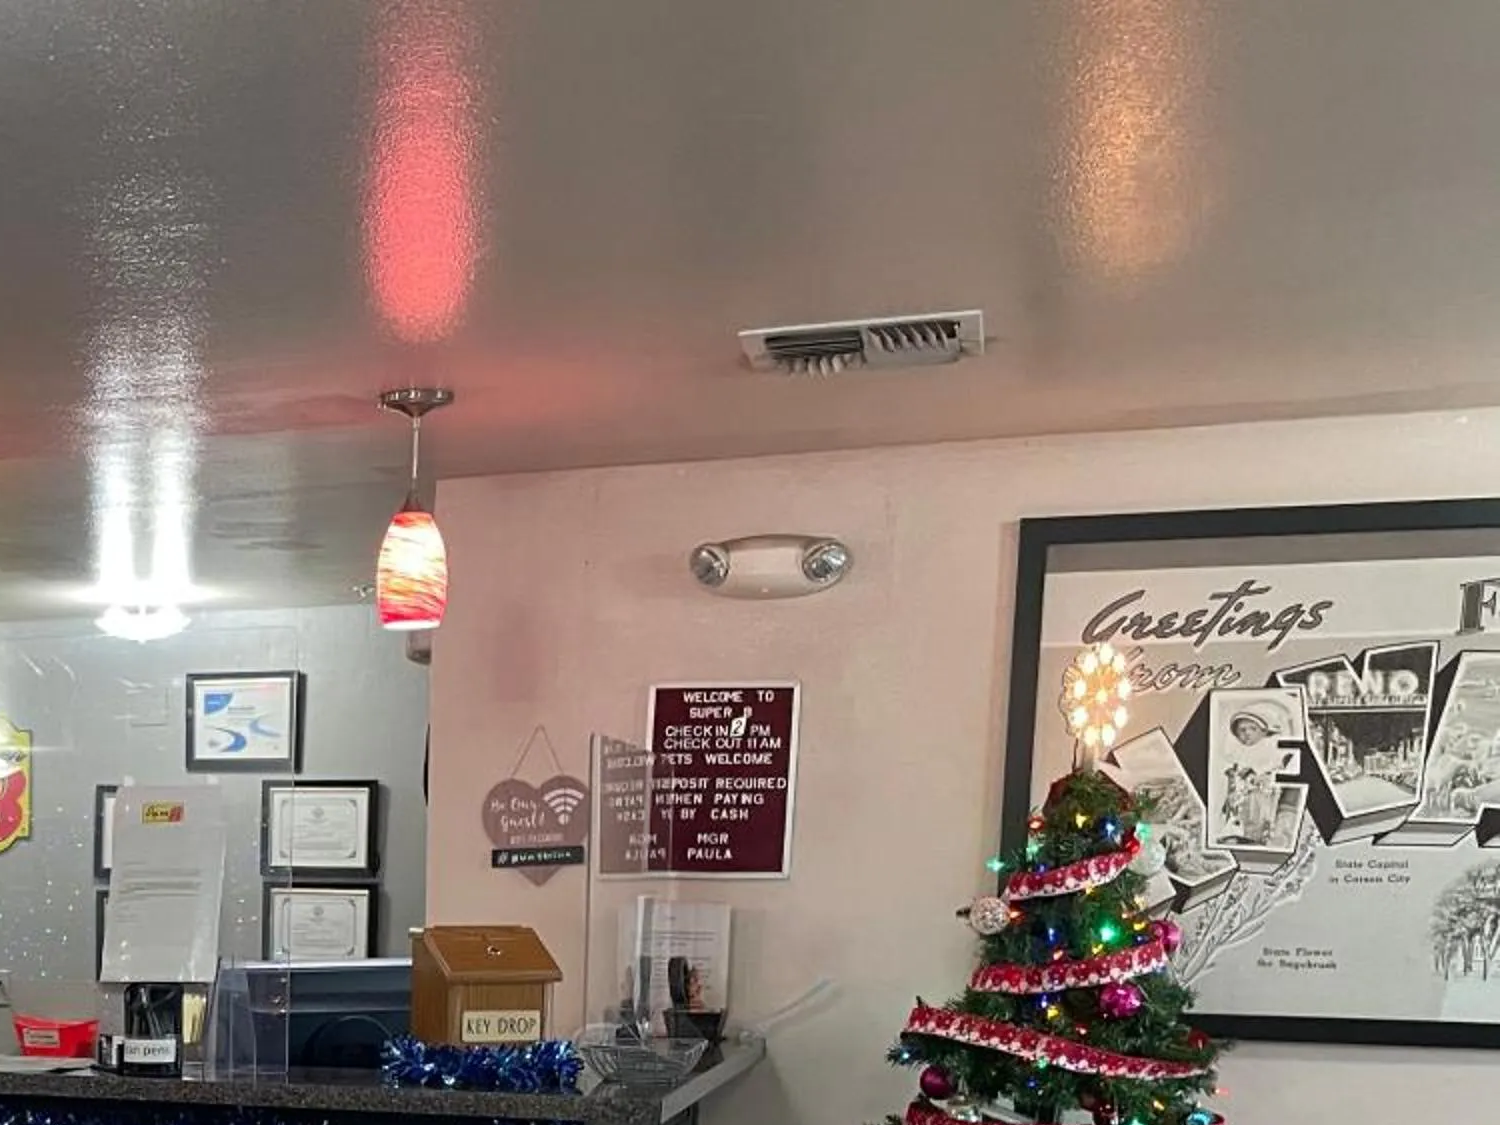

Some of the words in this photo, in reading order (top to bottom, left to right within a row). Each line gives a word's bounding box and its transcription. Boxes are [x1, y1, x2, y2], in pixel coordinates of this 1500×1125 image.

[1081, 580, 1334, 652] Greetings
[683, 691, 744, 703] WELCOME
[756, 690, 775, 703] TO
[689, 706, 733, 719] SUPER
[665, 725, 713, 737] CHECK
[749, 724, 771, 736] PM
[663, 737, 711, 749] CHECK
[715, 738, 742, 749] OUT
[759, 737, 782, 749] AM
[705, 753, 773, 765] WELCOME
[715, 777, 787, 789] REQUIRED
[713, 793, 765, 805] PAYING
[680, 808, 697, 820] BY
[710, 808, 749, 820] CASH
[697, 833, 730, 844] MGR
[687, 848, 733, 860] PAULA
[1388, 874, 1411, 884] City
[467, 1018, 491, 1035] KEY
[497, 1018, 537, 1035] DROP
